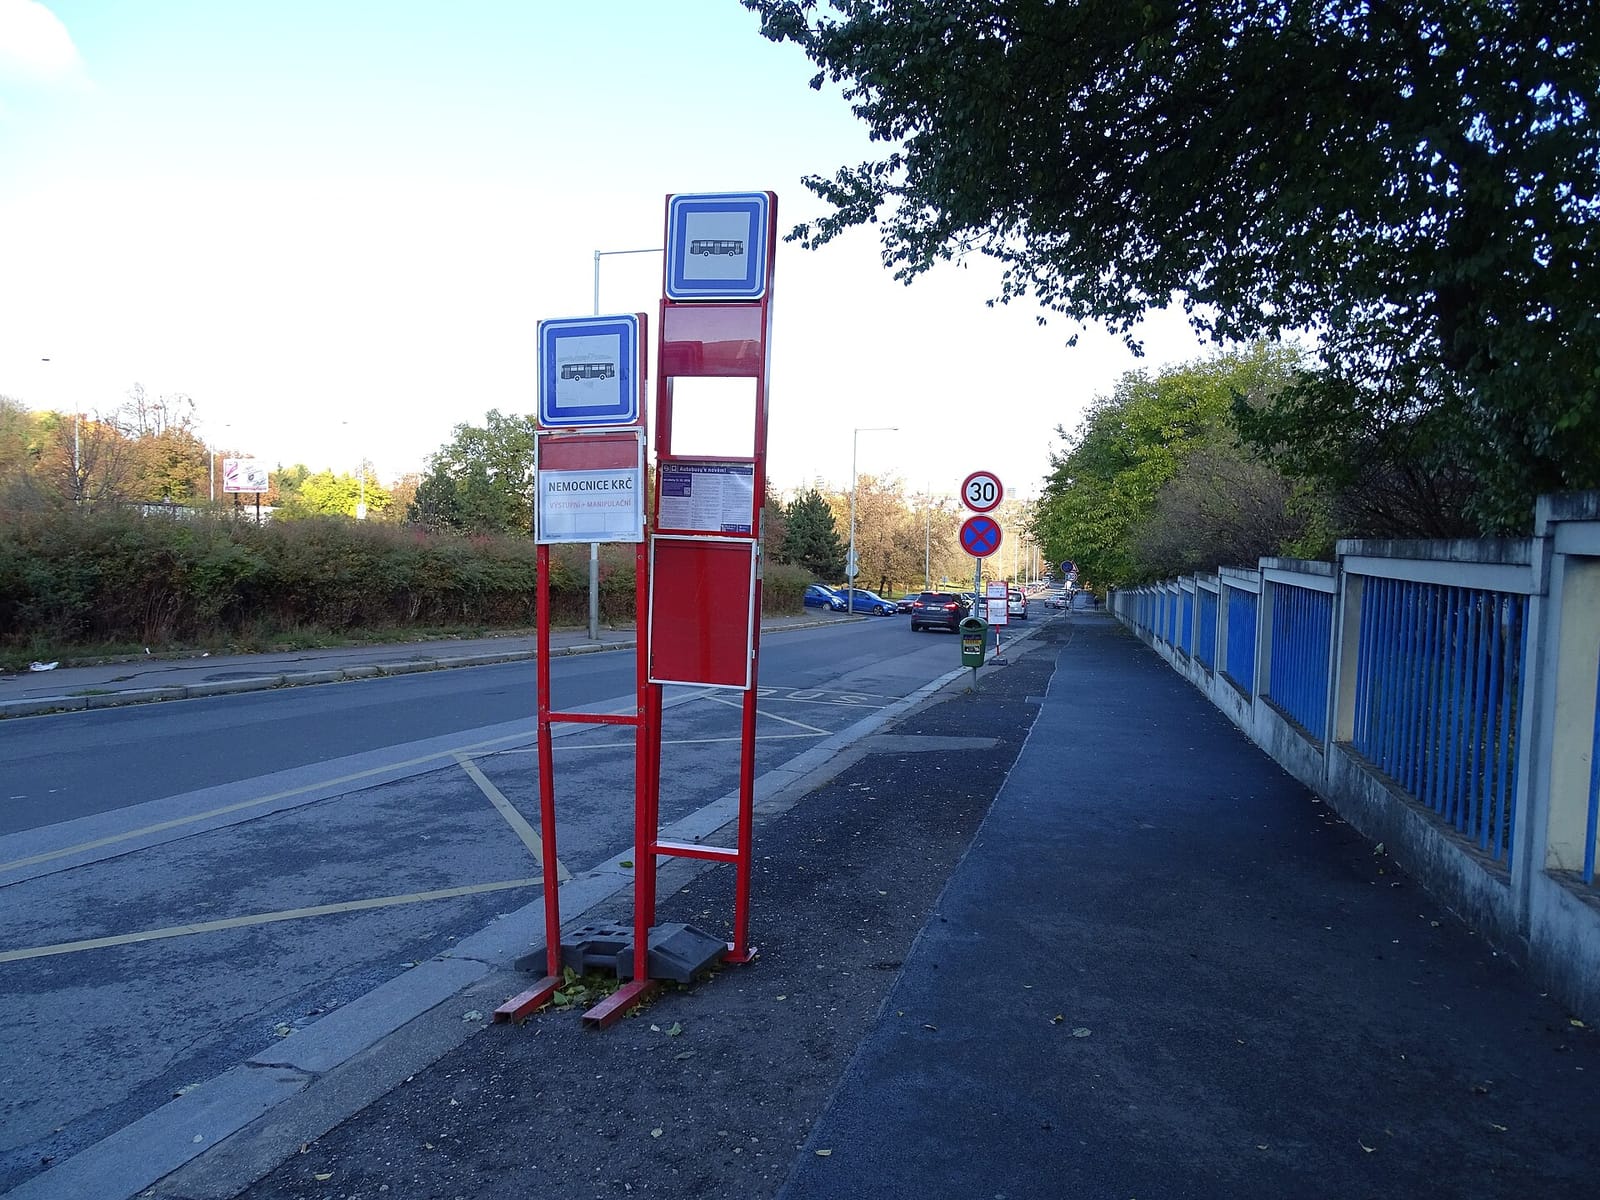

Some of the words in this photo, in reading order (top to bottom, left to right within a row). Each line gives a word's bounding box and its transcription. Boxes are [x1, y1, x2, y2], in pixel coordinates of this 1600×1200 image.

[549, 479, 609, 492] NEMOCNICE
[611, 477, 632, 490] KRČ
[970, 482, 995, 502] 30
[587, 498, 632, 509] MANIPULAČNÍ
